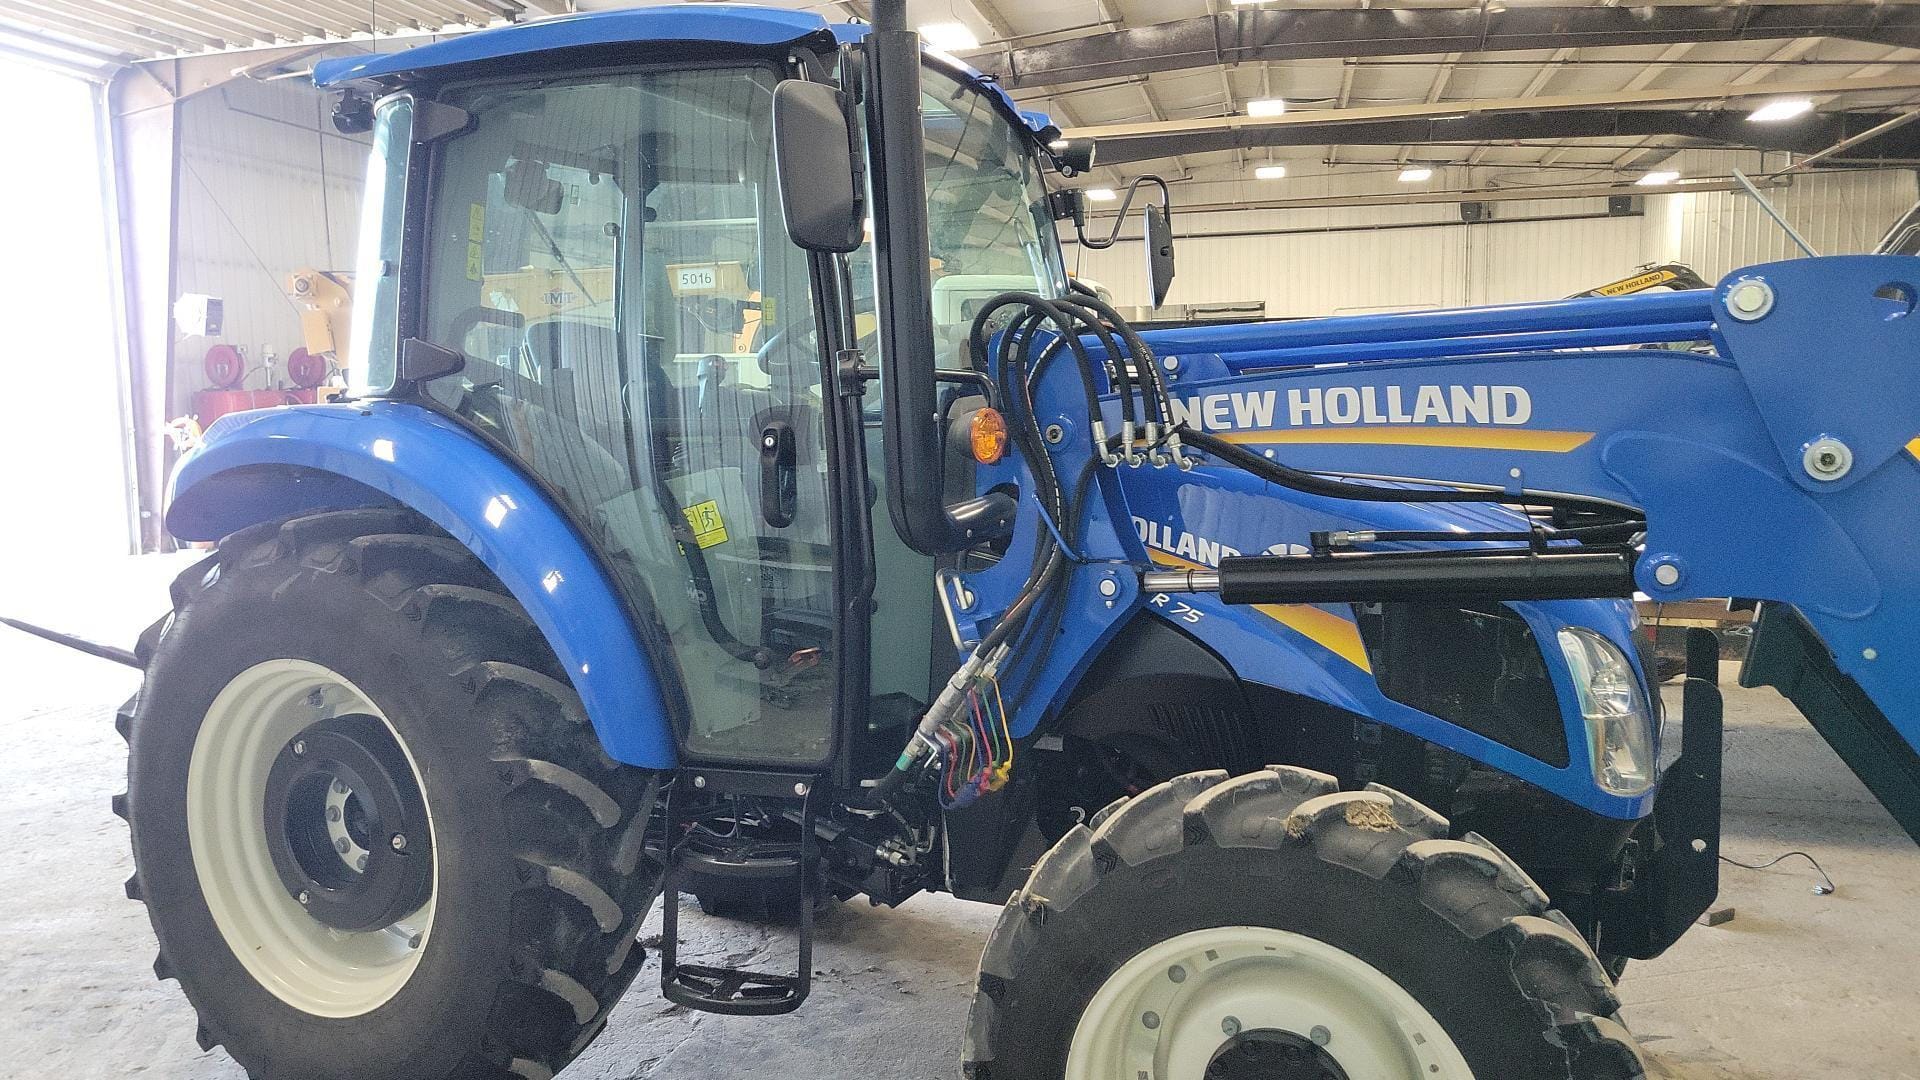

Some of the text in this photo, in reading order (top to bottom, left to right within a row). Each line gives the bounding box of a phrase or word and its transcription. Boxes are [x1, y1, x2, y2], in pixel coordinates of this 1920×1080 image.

[682, 272, 712, 285] 5016
[1607, 274, 1660, 295] NEW HOLLAND
[1170, 385, 1532, 431] NEW HOLLAND
[1130, 515, 1242, 568] OLLAN
[1169, 601, 1205, 623] 75
